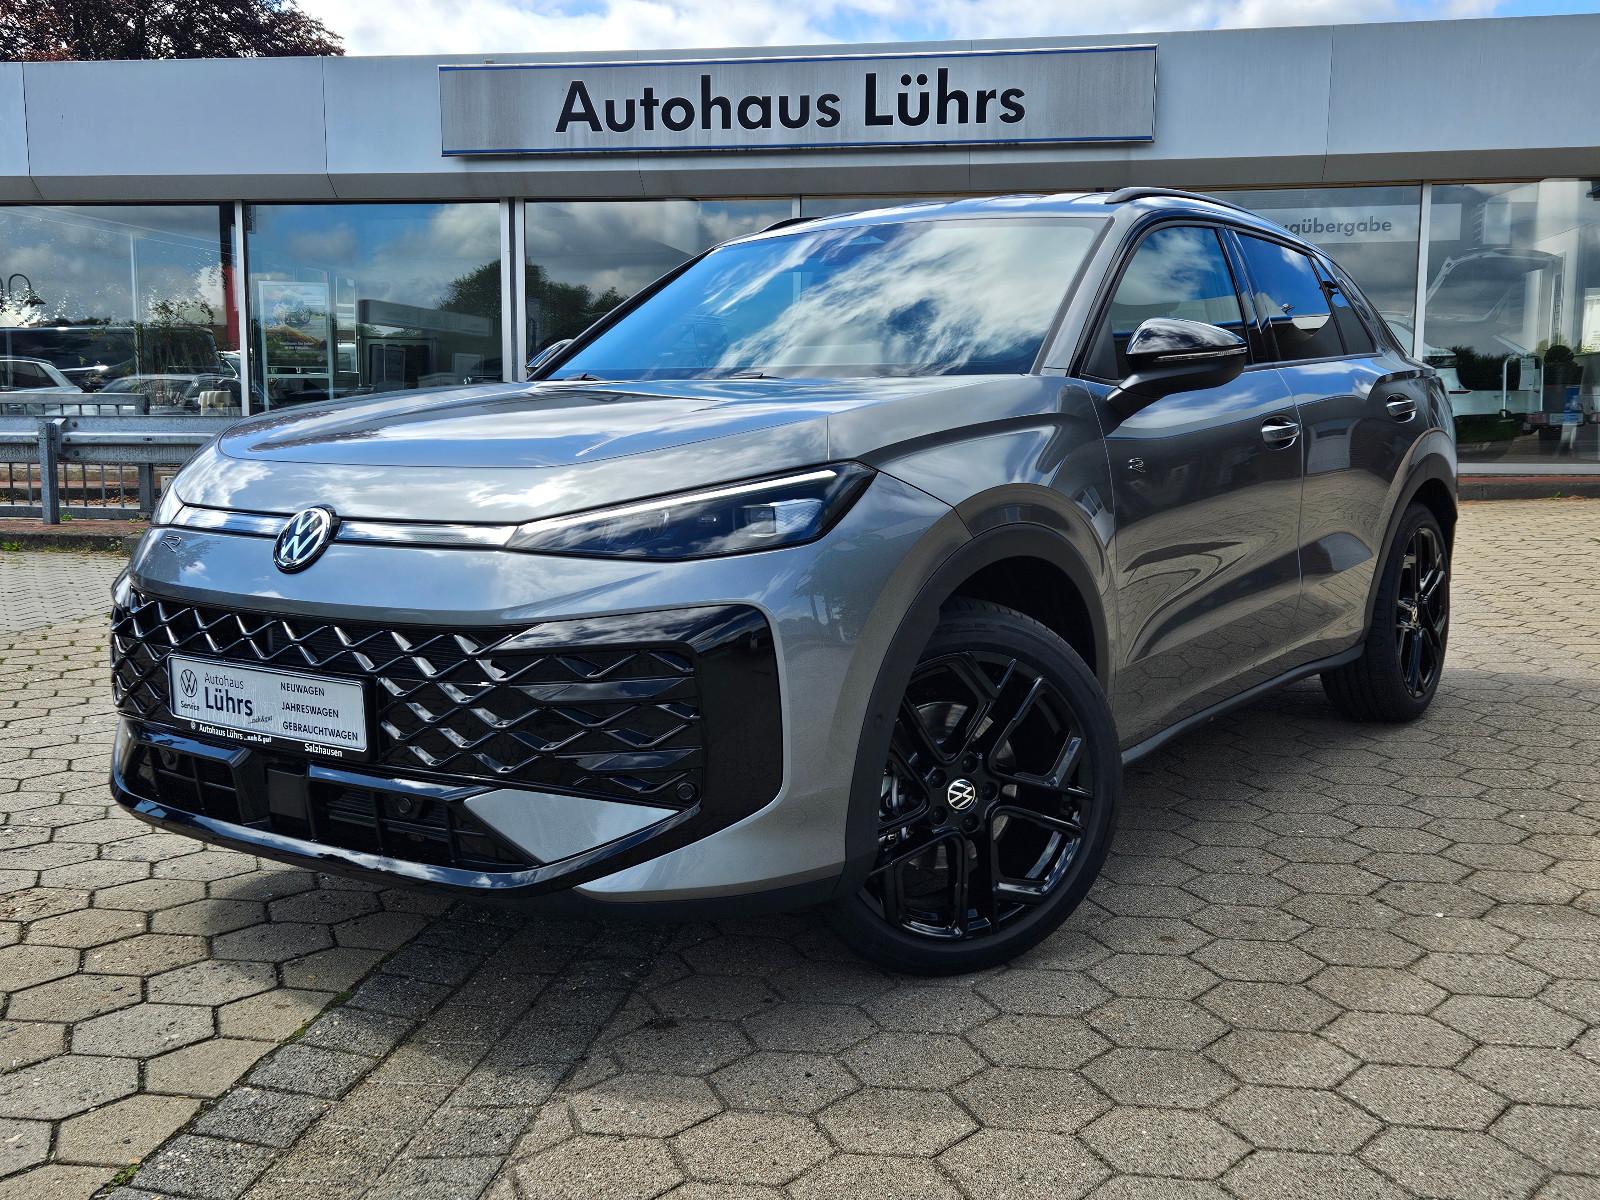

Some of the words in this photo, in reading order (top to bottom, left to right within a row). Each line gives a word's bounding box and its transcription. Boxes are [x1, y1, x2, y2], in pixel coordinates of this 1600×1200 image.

[555, 75, 841, 133] Autohaus
[864, 67, 1027, 126] Lührs
[1284, 216, 1392, 236] gübergabe
[204, 673, 244, 690] Autohaus
[280, 682, 325, 697] NEUWAGEN
[180, 700, 200, 712] Service
[205, 687, 254, 717] Lührs
[281, 702, 339, 718] JAHRESWAGEN
[199, 724, 226, 737] Autohaus
[226, 730, 243, 740] Lührs
[282, 721, 358, 741] GEBRAUCHTWAGEN
[304, 743, 343, 757] Salzhausen
